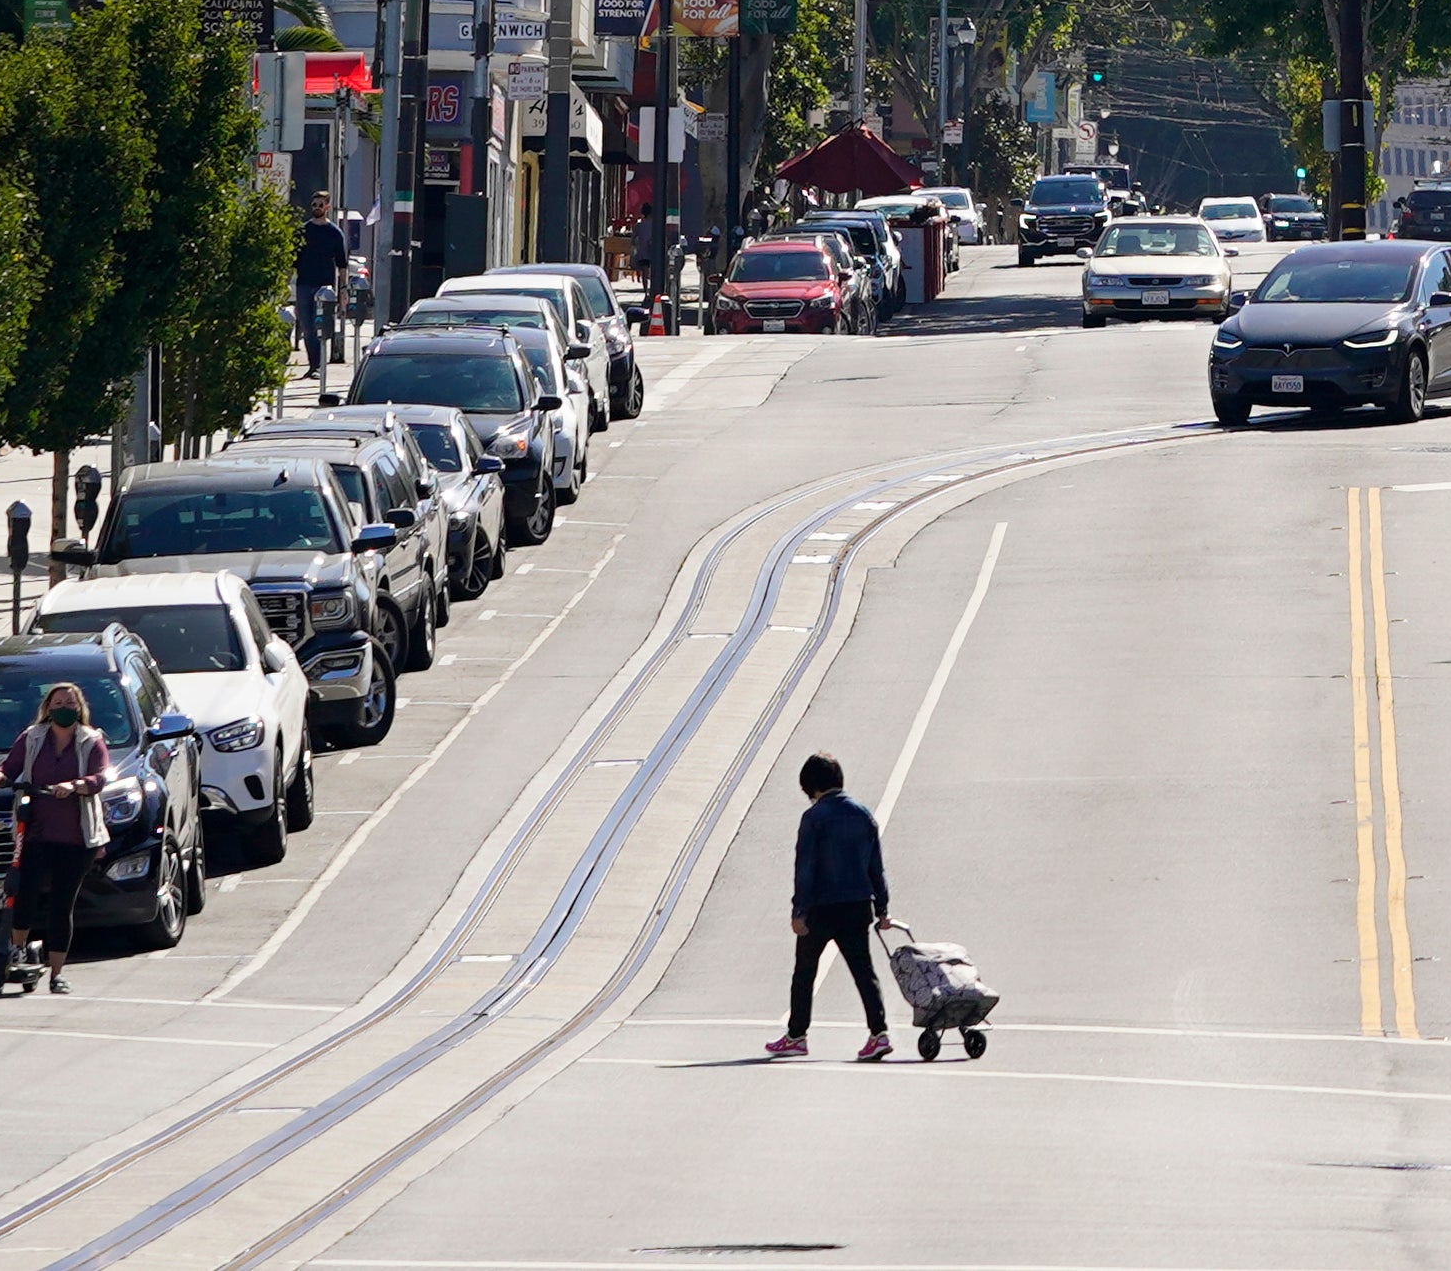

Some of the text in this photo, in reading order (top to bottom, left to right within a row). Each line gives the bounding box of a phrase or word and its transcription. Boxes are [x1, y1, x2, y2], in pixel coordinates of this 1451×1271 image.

[599, 0, 645, 9] FOOD FOR
[749, 0, 776, 9] FOOD
[250, 11, 263, 20] OF
[599, 9, 646, 19] STRENGTH
[683, 4, 729, 20] FOR all
[748, 6, 791, 19] FOR all
[509, 64, 520, 74] NO
[260, 153, 271, 166] NO
